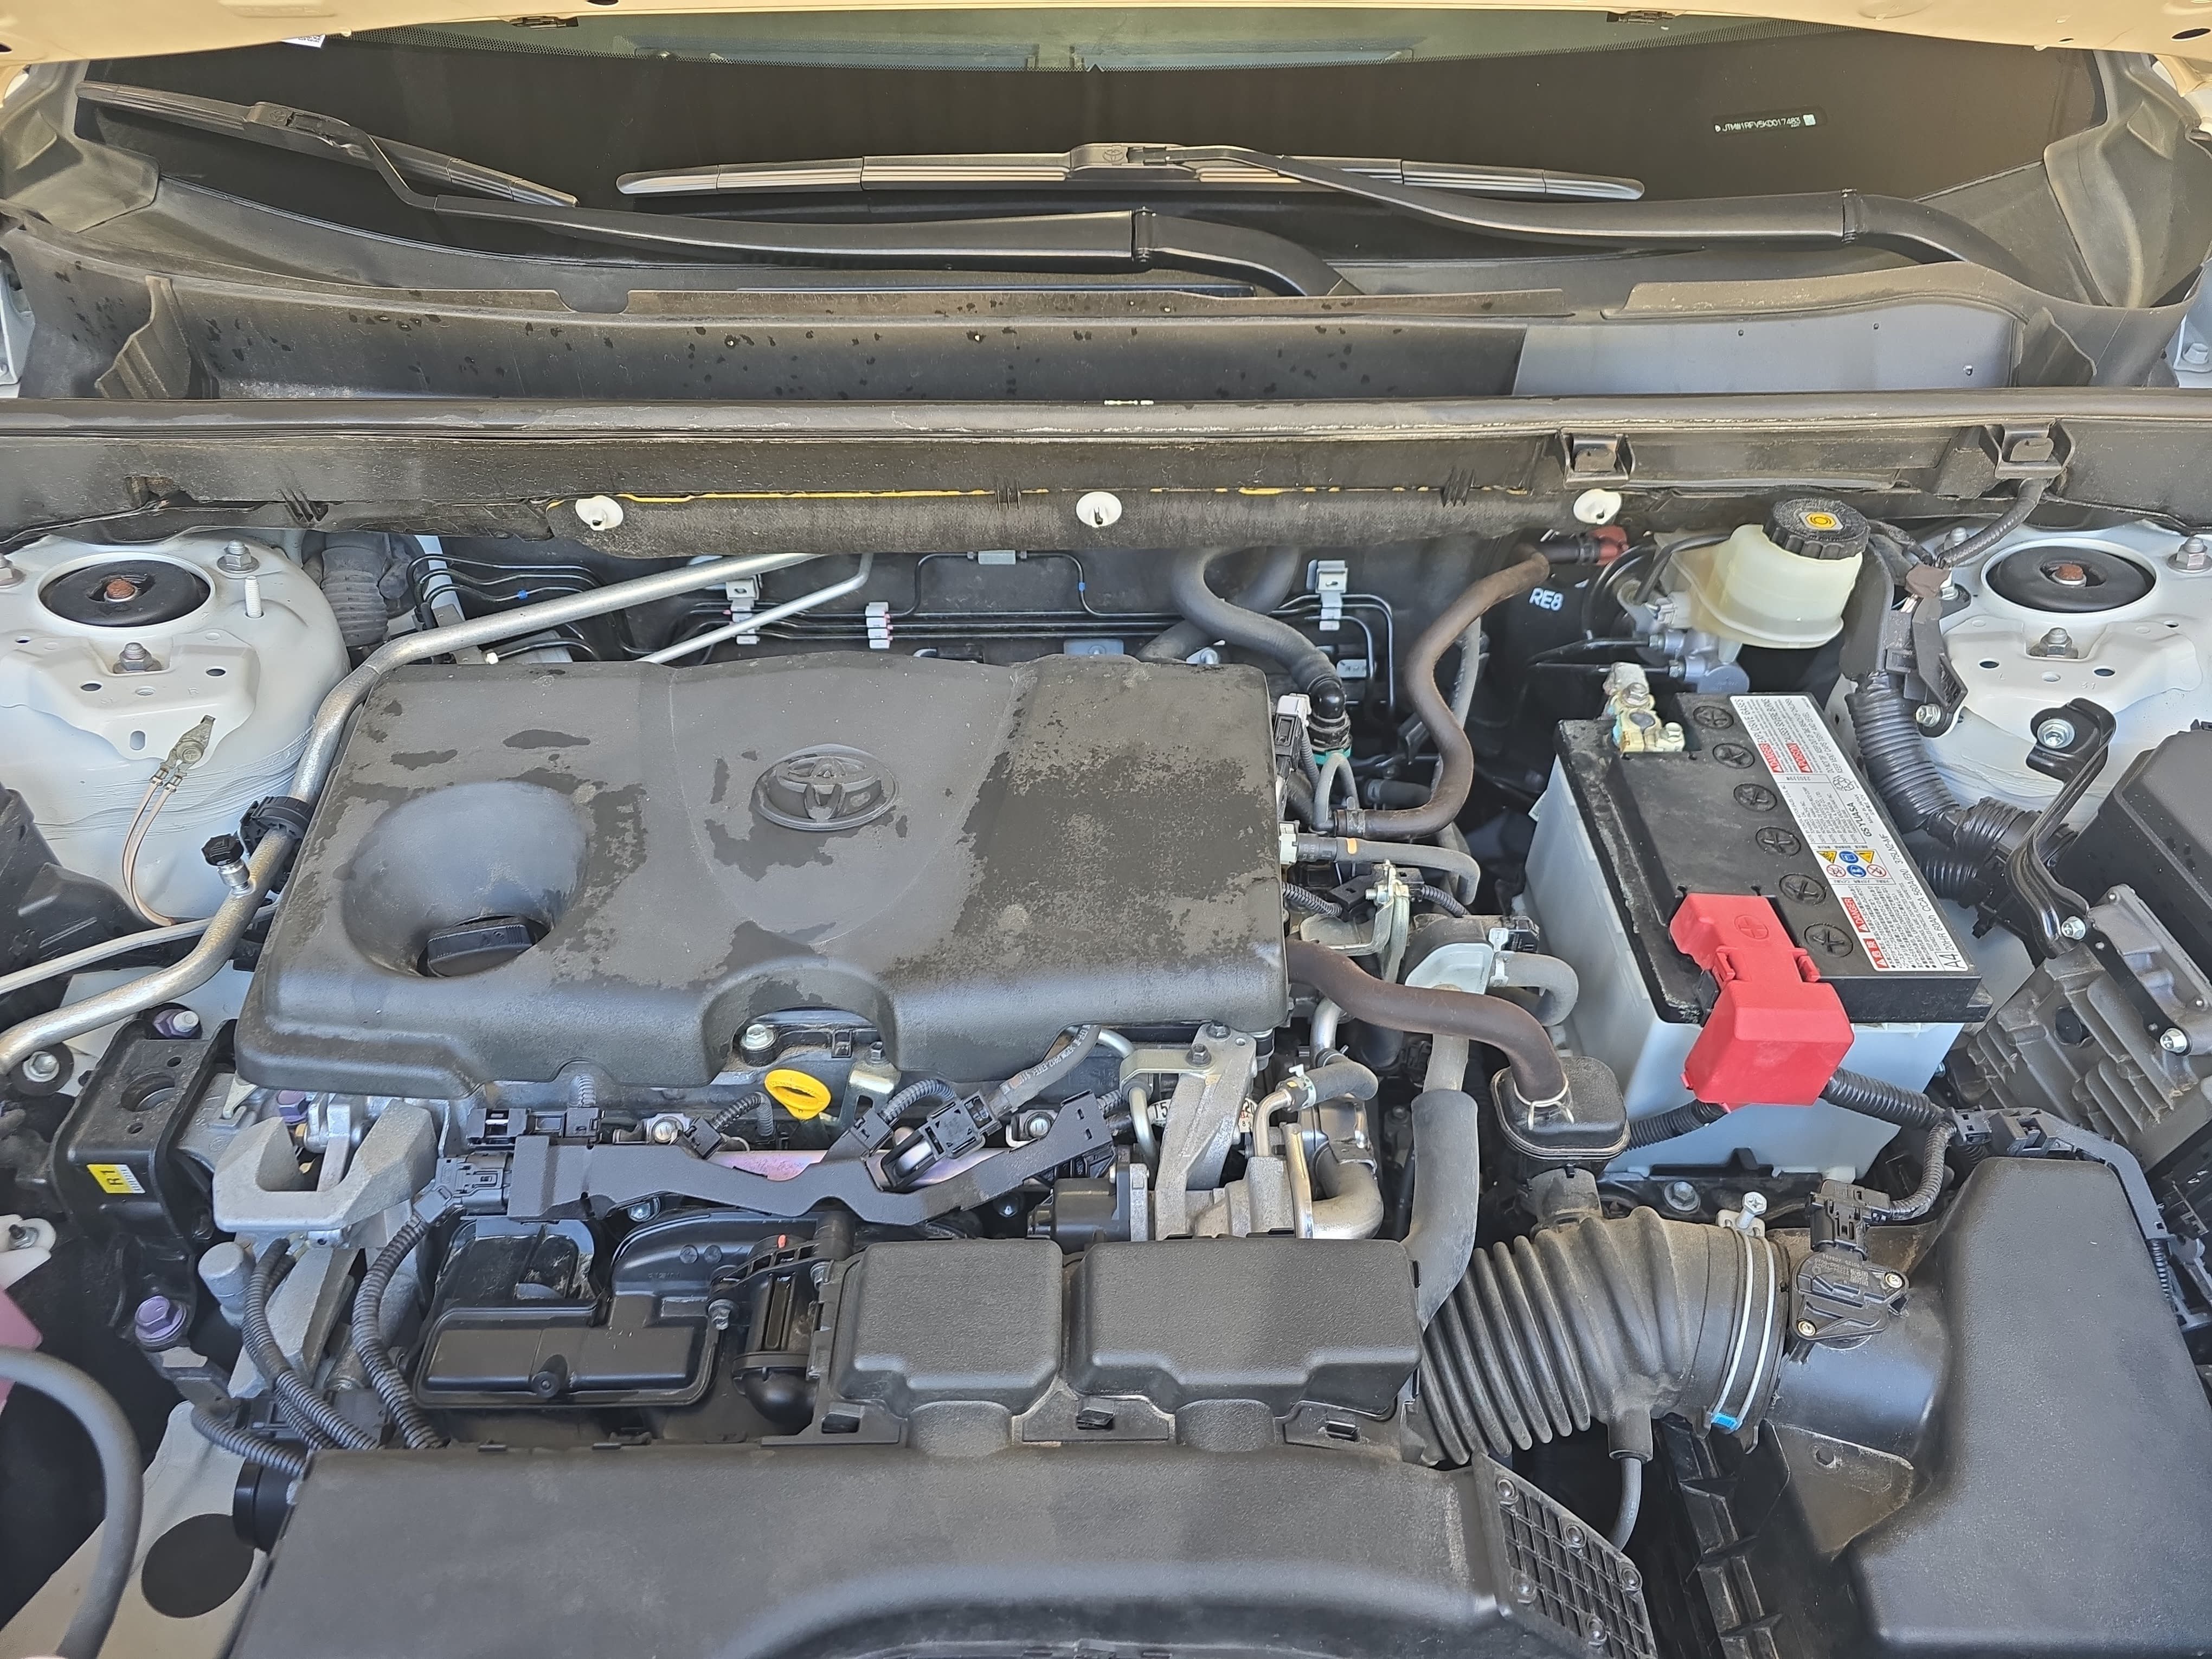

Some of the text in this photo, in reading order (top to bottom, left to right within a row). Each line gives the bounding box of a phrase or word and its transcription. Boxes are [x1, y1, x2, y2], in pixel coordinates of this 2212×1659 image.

[1529, 588, 1564, 610] RE8
[1846, 802, 1867, 827] YUASA
[1860, 827, 1873, 836] GS
[1878, 833, 1904, 864] 375LN2-MF
[1899, 869, 1922, 895] 560A(EN)
[1843, 898, 1864, 923] DANGER
[1915, 897, 1932, 911] CCA
[1926, 915, 1943, 930] 60Ah
[1936, 933, 1955, 950] 20HR
[1937, 954, 1966, 968] A4
[100, 1170, 123, 1185] R1
